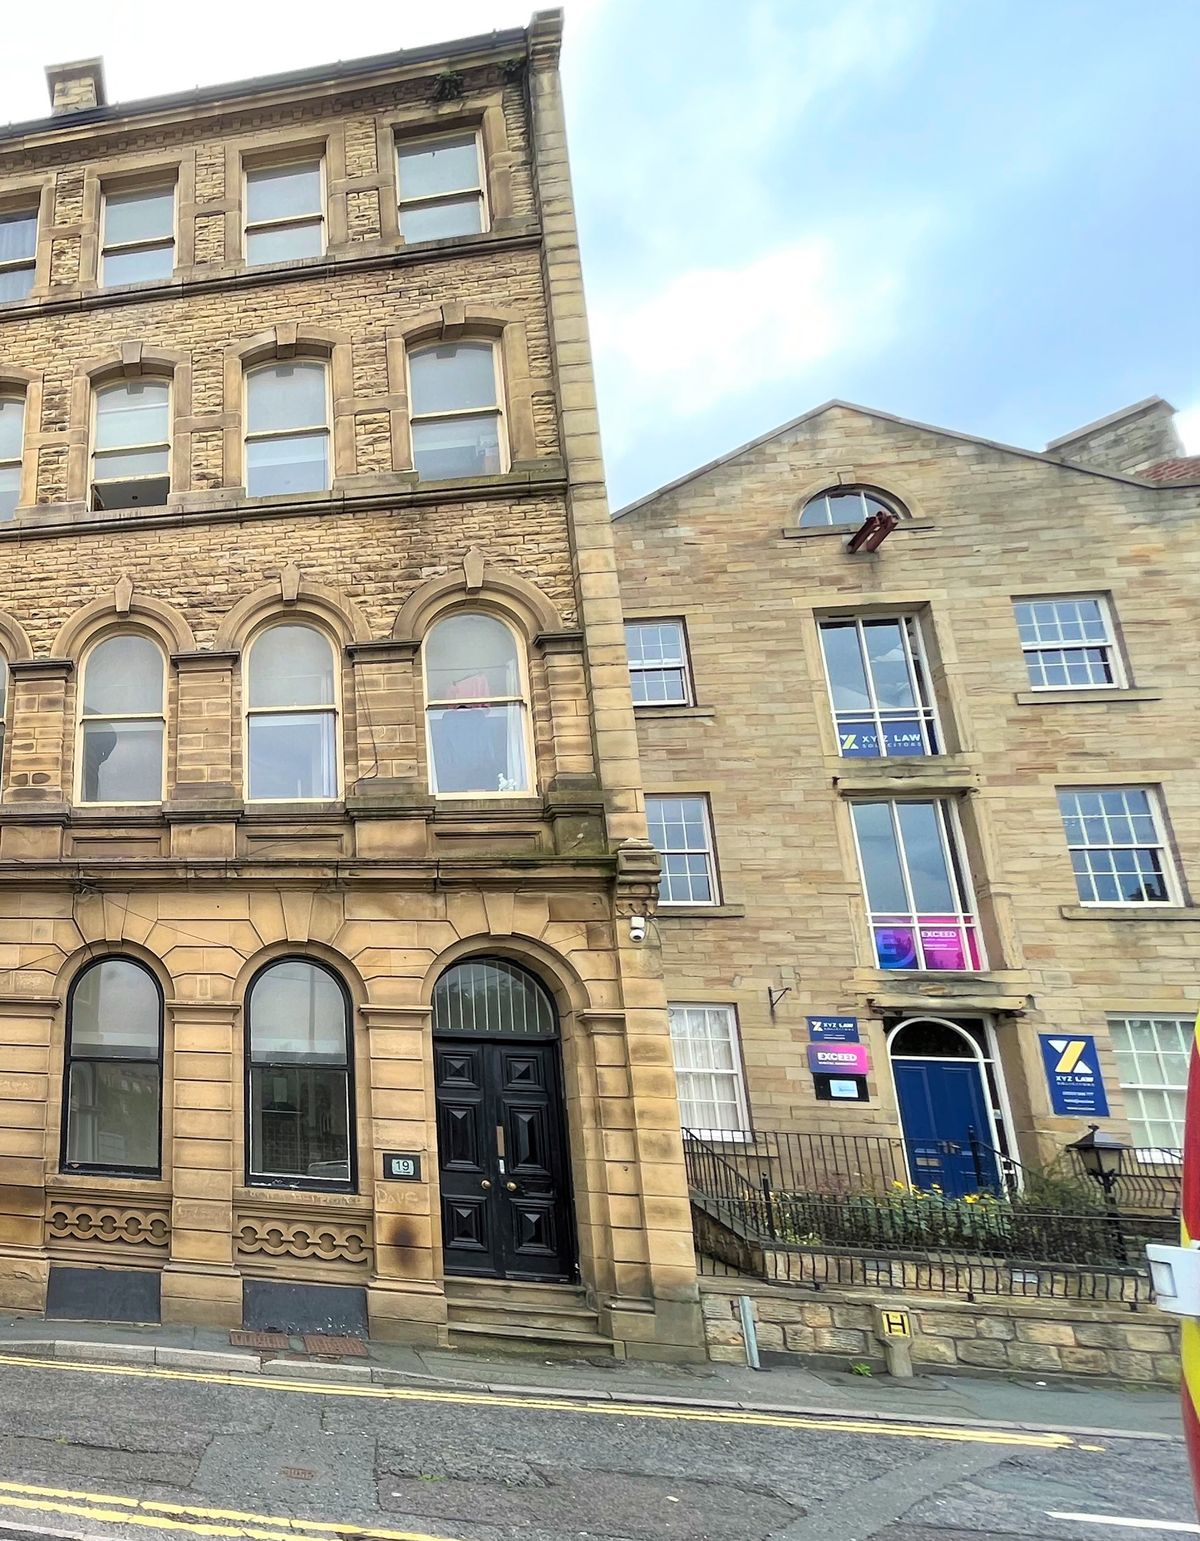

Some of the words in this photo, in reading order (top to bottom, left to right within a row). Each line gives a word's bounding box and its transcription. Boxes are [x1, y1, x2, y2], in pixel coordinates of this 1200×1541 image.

[893, 734, 921, 742] LAW
[921, 930, 957, 938] EXCEED
[817, 1052, 858, 1062] EXCEED
[395, 1160, 410, 1171] 19
[885, 1313, 907, 1335] H
